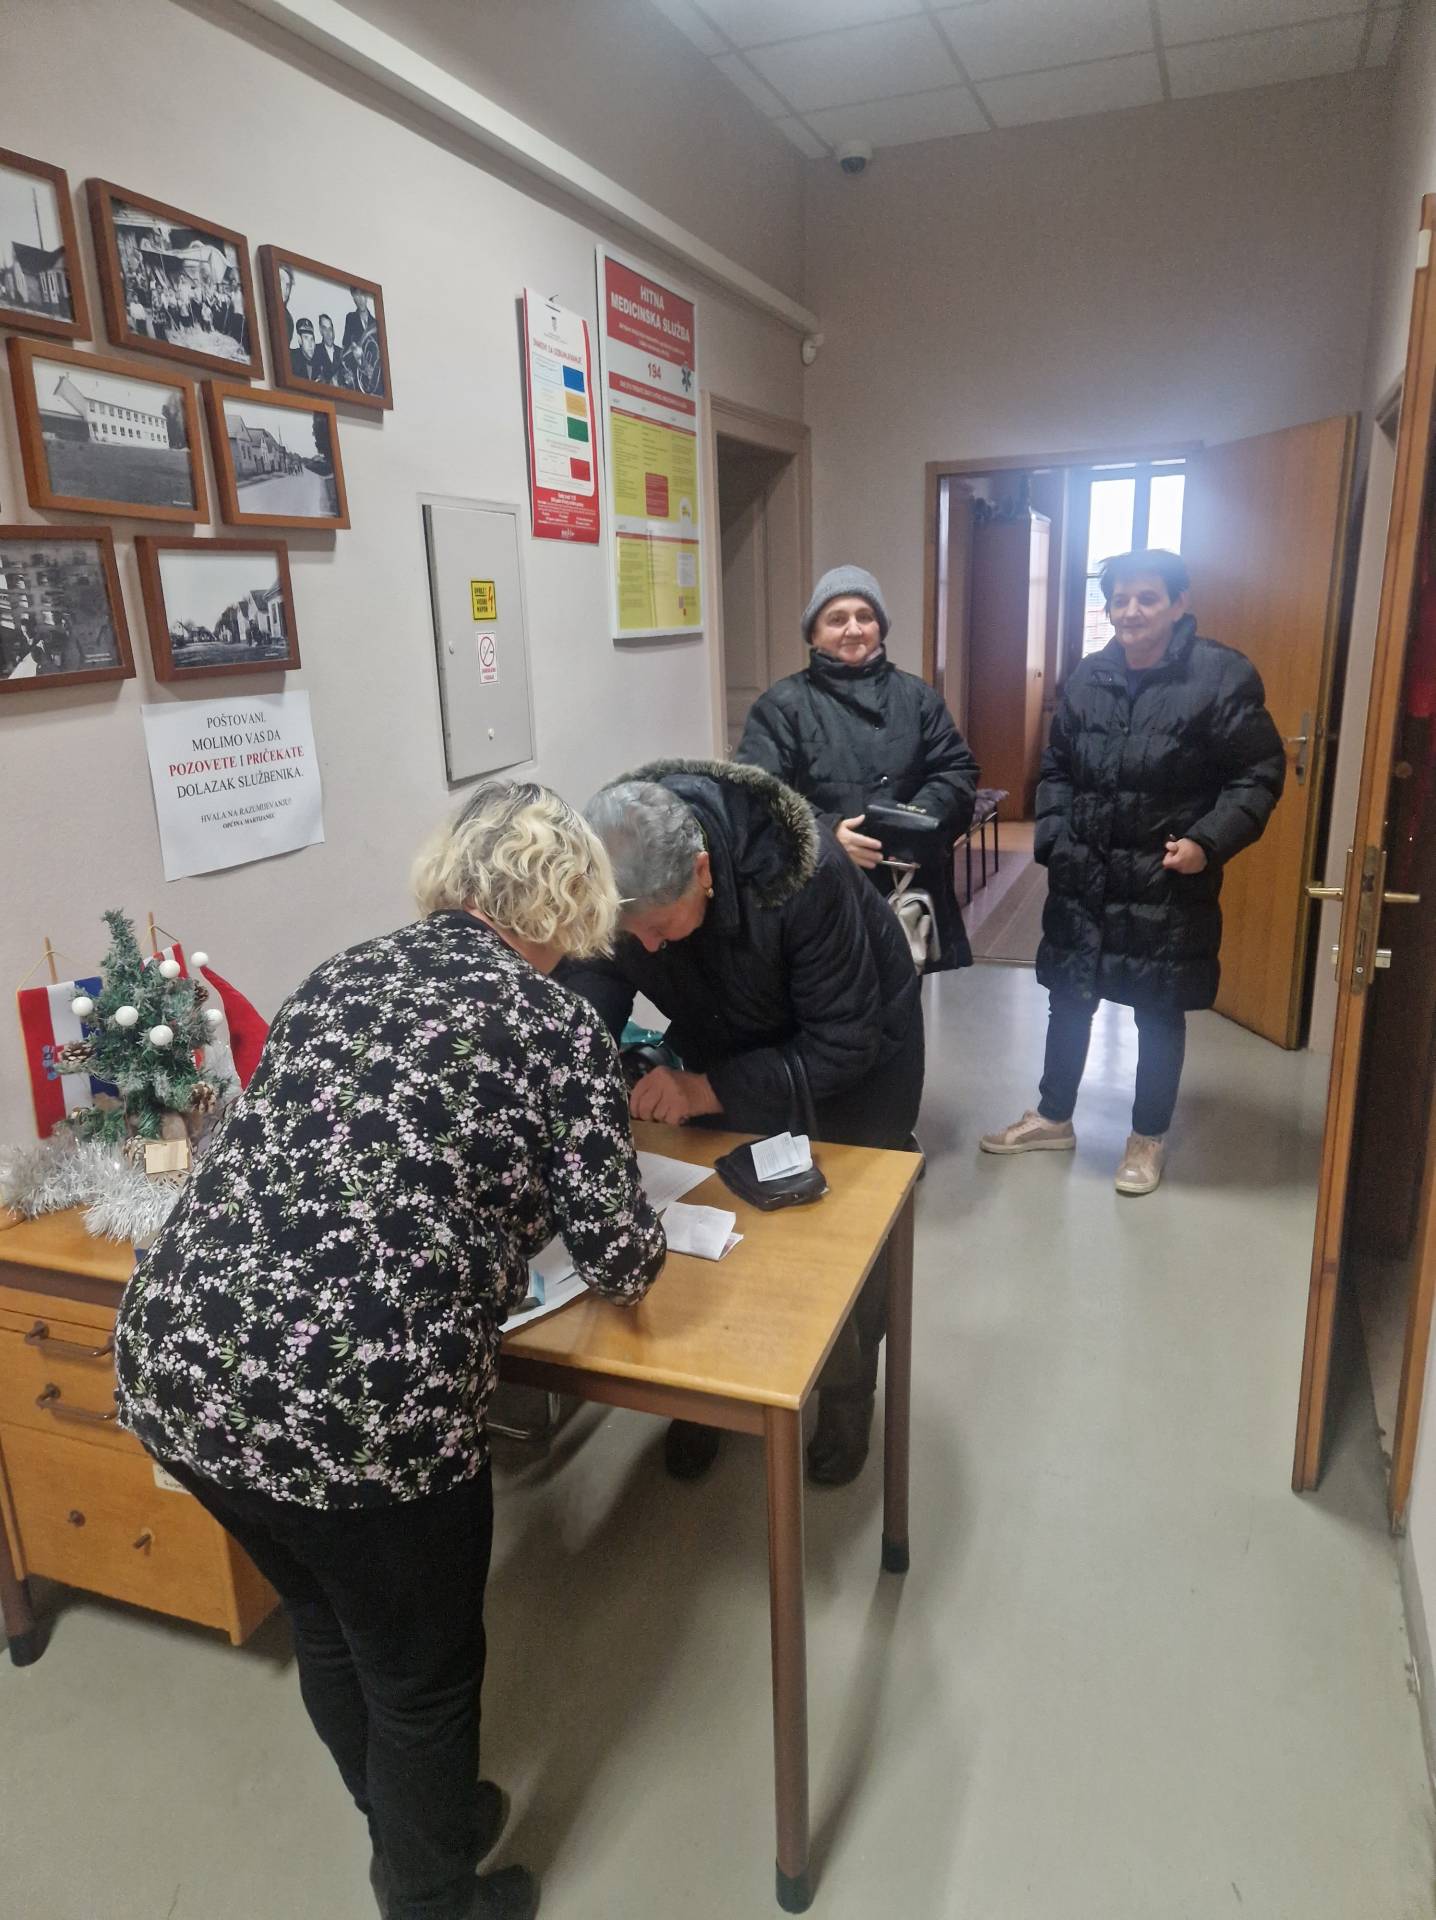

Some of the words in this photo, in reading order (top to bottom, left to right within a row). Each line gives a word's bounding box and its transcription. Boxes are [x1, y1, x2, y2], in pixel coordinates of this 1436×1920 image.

[640, 284, 664, 311] HITNA
[611, 290, 661, 331] MEDICINSKA
[662, 318, 690, 342] SLUŽBA
[648, 362, 662, 380] 194
[192, 734, 243, 751] MOLIMO
[245, 731, 265, 745] VAS
[267, 729, 281, 742] DA
[169, 756, 237, 777] POZOVETE
[239, 756, 244, 767] I
[246, 745, 304, 766] PRIČEKATE
[176, 777, 236, 799] DOLAZAK
[201, 812, 227, 824] HVALA
[227, 808, 238, 817] NA
